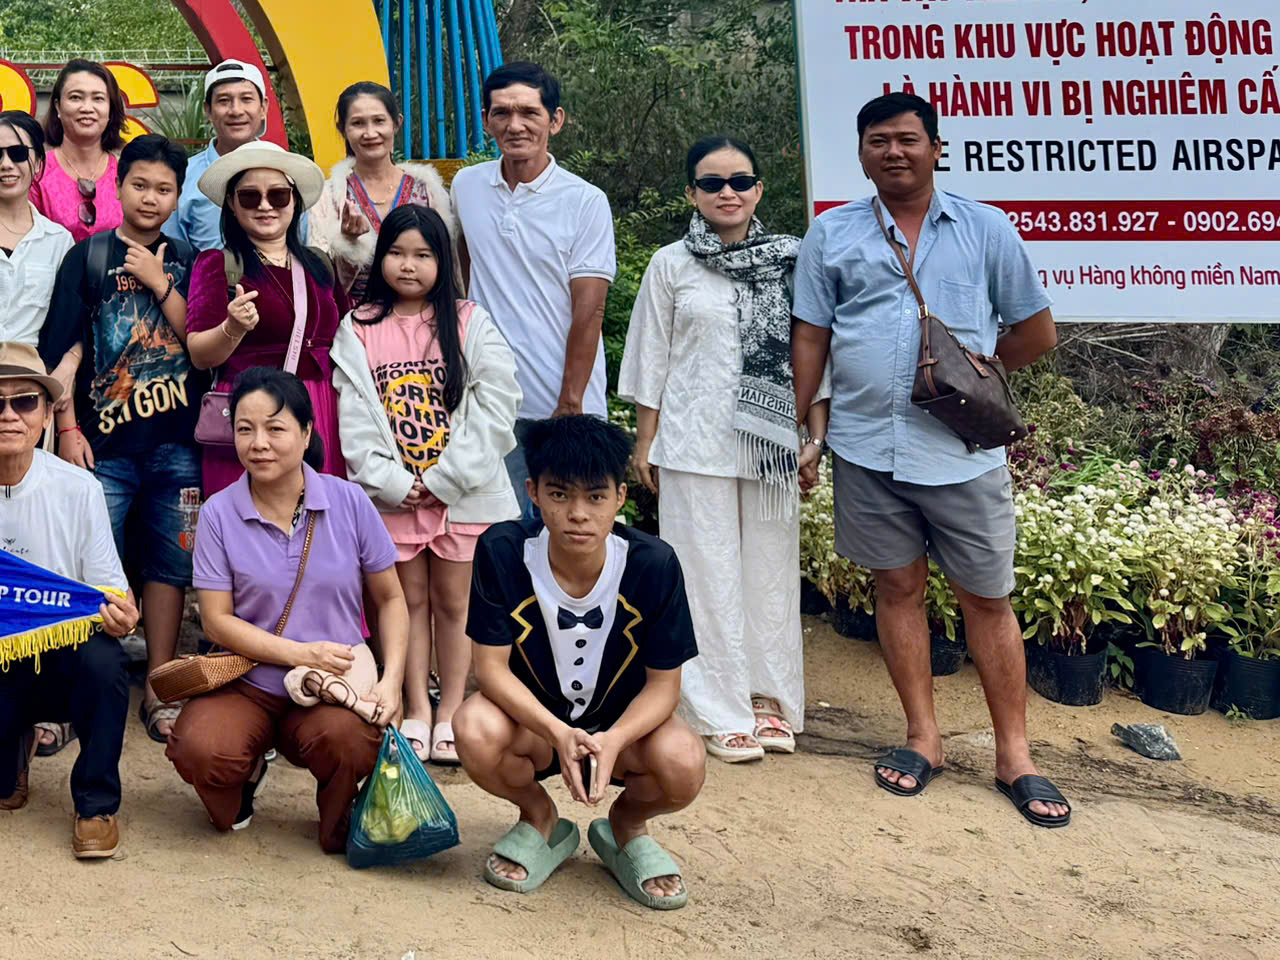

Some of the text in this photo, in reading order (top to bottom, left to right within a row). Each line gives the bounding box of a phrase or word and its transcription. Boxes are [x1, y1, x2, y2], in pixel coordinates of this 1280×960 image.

[844, 12, 1273, 65] TRONG KHU VỰC HOẠT ĐỘNG
[929, 74, 1013, 116] HÀNH
[1022, 81, 1052, 116] VI
[1061, 80, 1093, 124] BỊ
[1102, 71, 1228, 116] NGHIÊM
[964, 140, 1157, 172] RESTRICTED
[1052, 269, 1074, 289] vụ
[1080, 265, 1126, 289] Hàng
[1130, 265, 1186, 290] không
[1191, 262, 1235, 285] miền
[1240, 266, 1280, 285] Nam
[13, 587, 71, 608] TOUR
